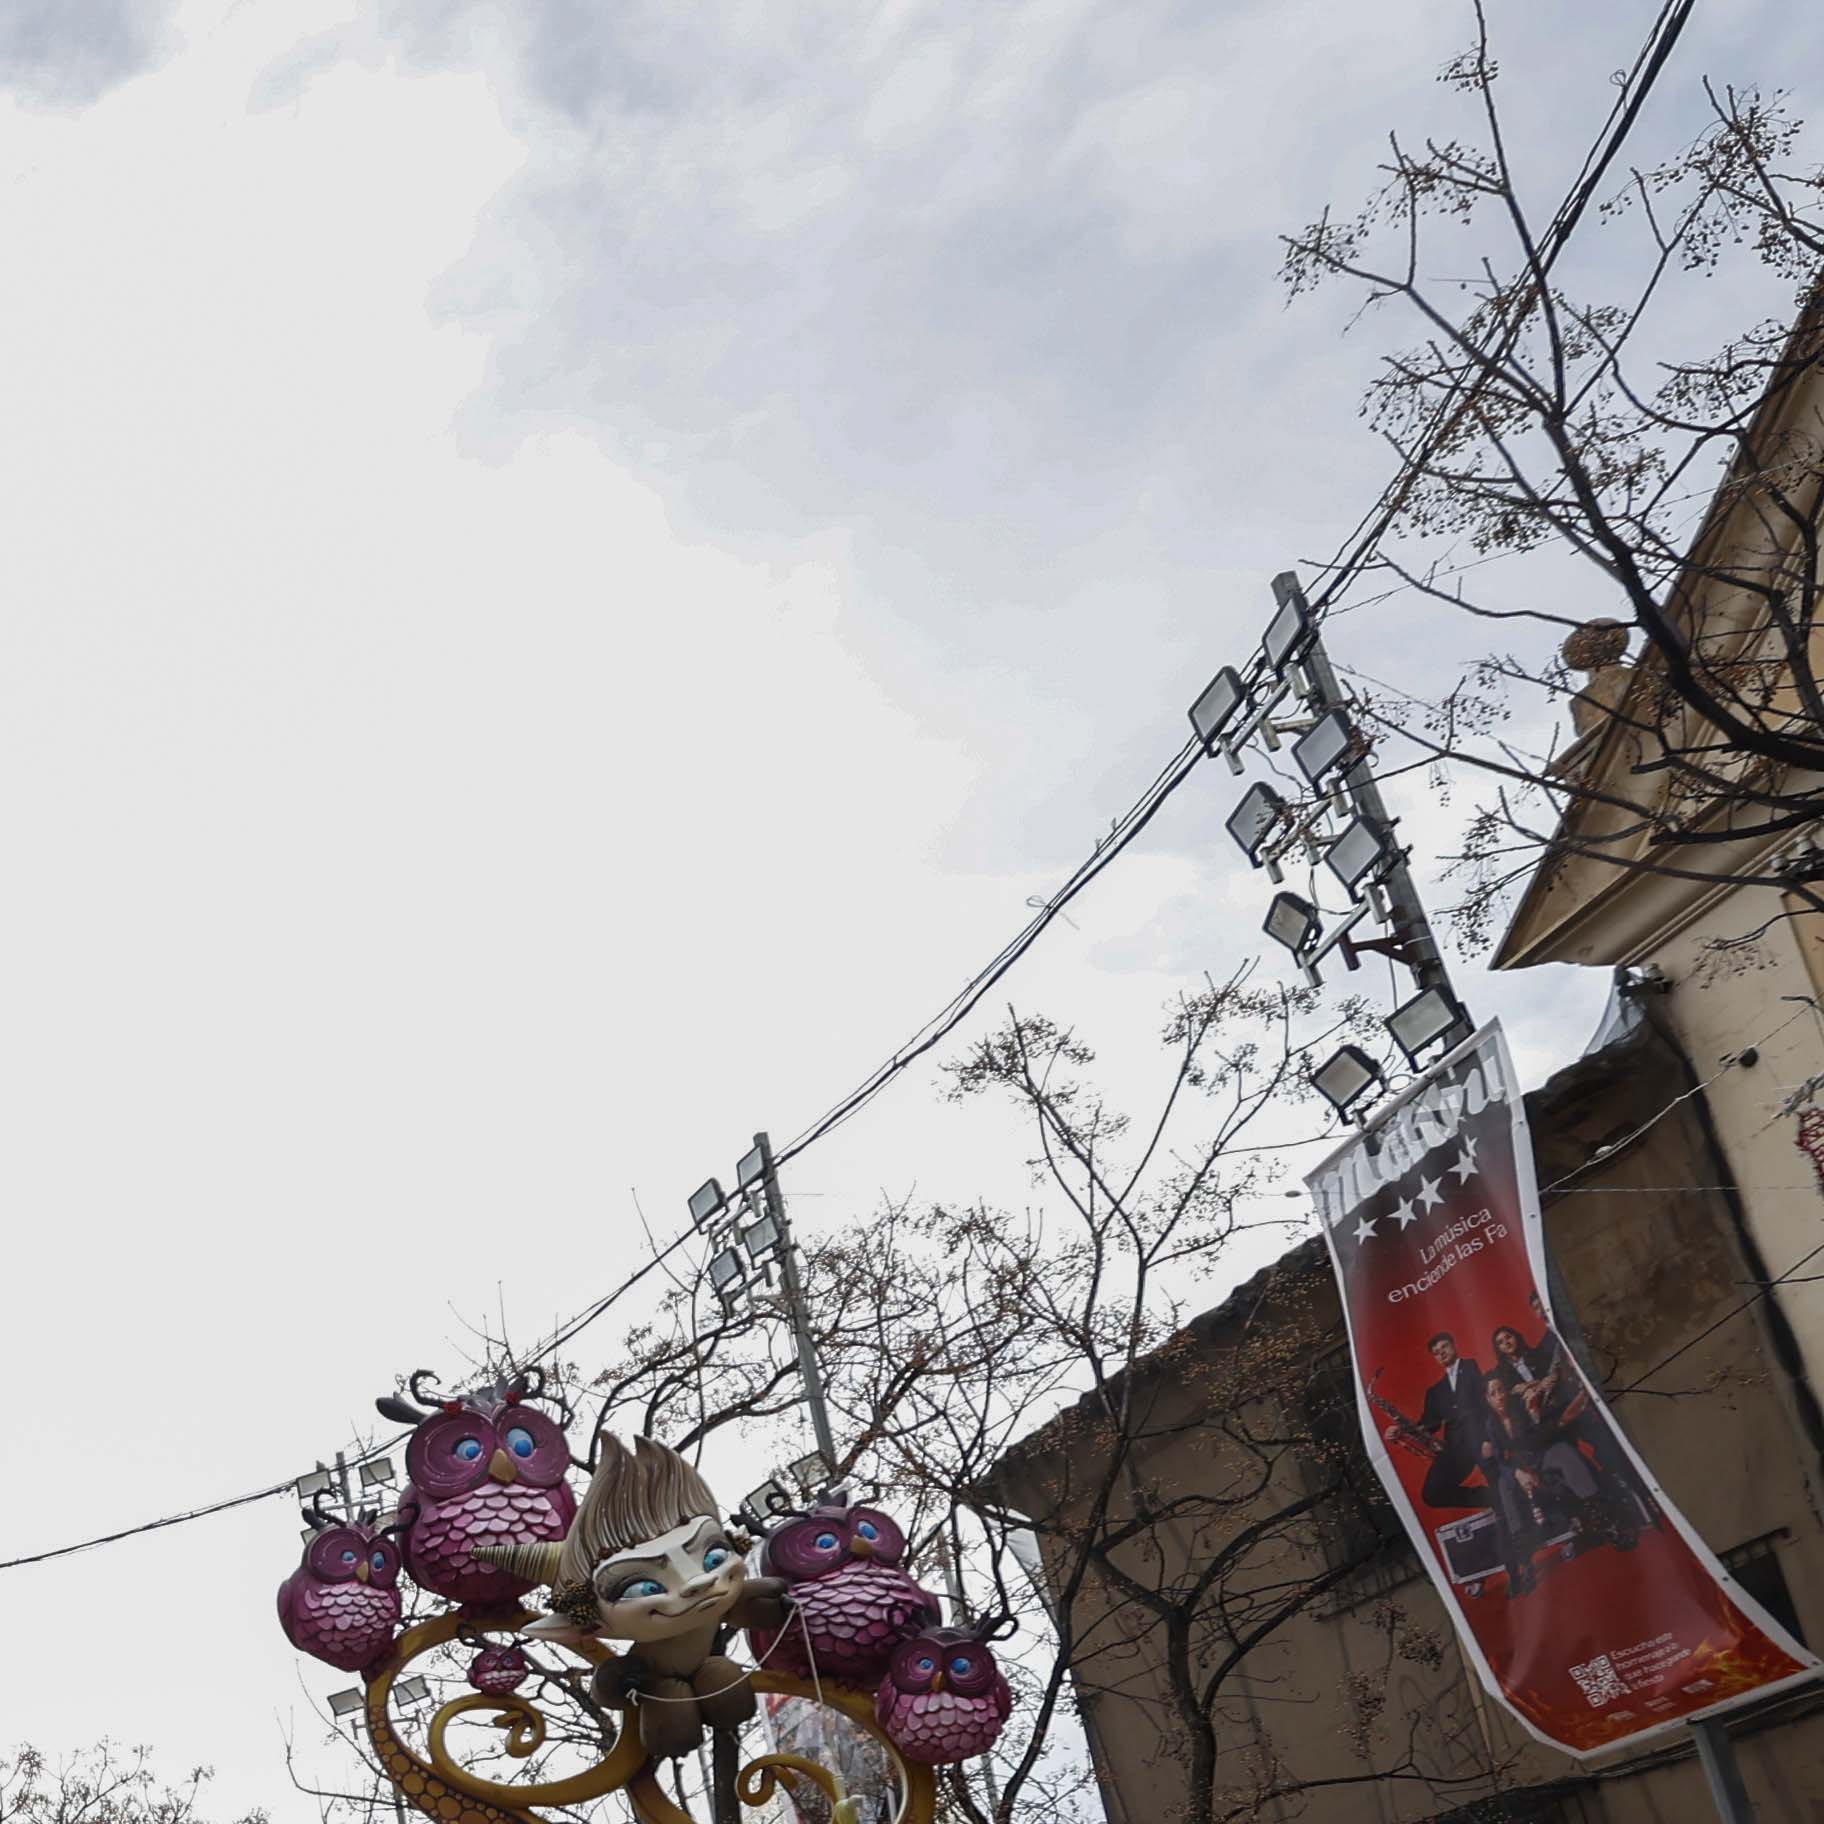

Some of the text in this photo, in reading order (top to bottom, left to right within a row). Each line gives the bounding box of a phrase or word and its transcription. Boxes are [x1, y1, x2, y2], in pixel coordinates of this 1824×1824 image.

[1419, 1207, 1493, 1265] La música
[1387, 1246, 1458, 1304] enciende
[1456, 1237, 1484, 1263] las
